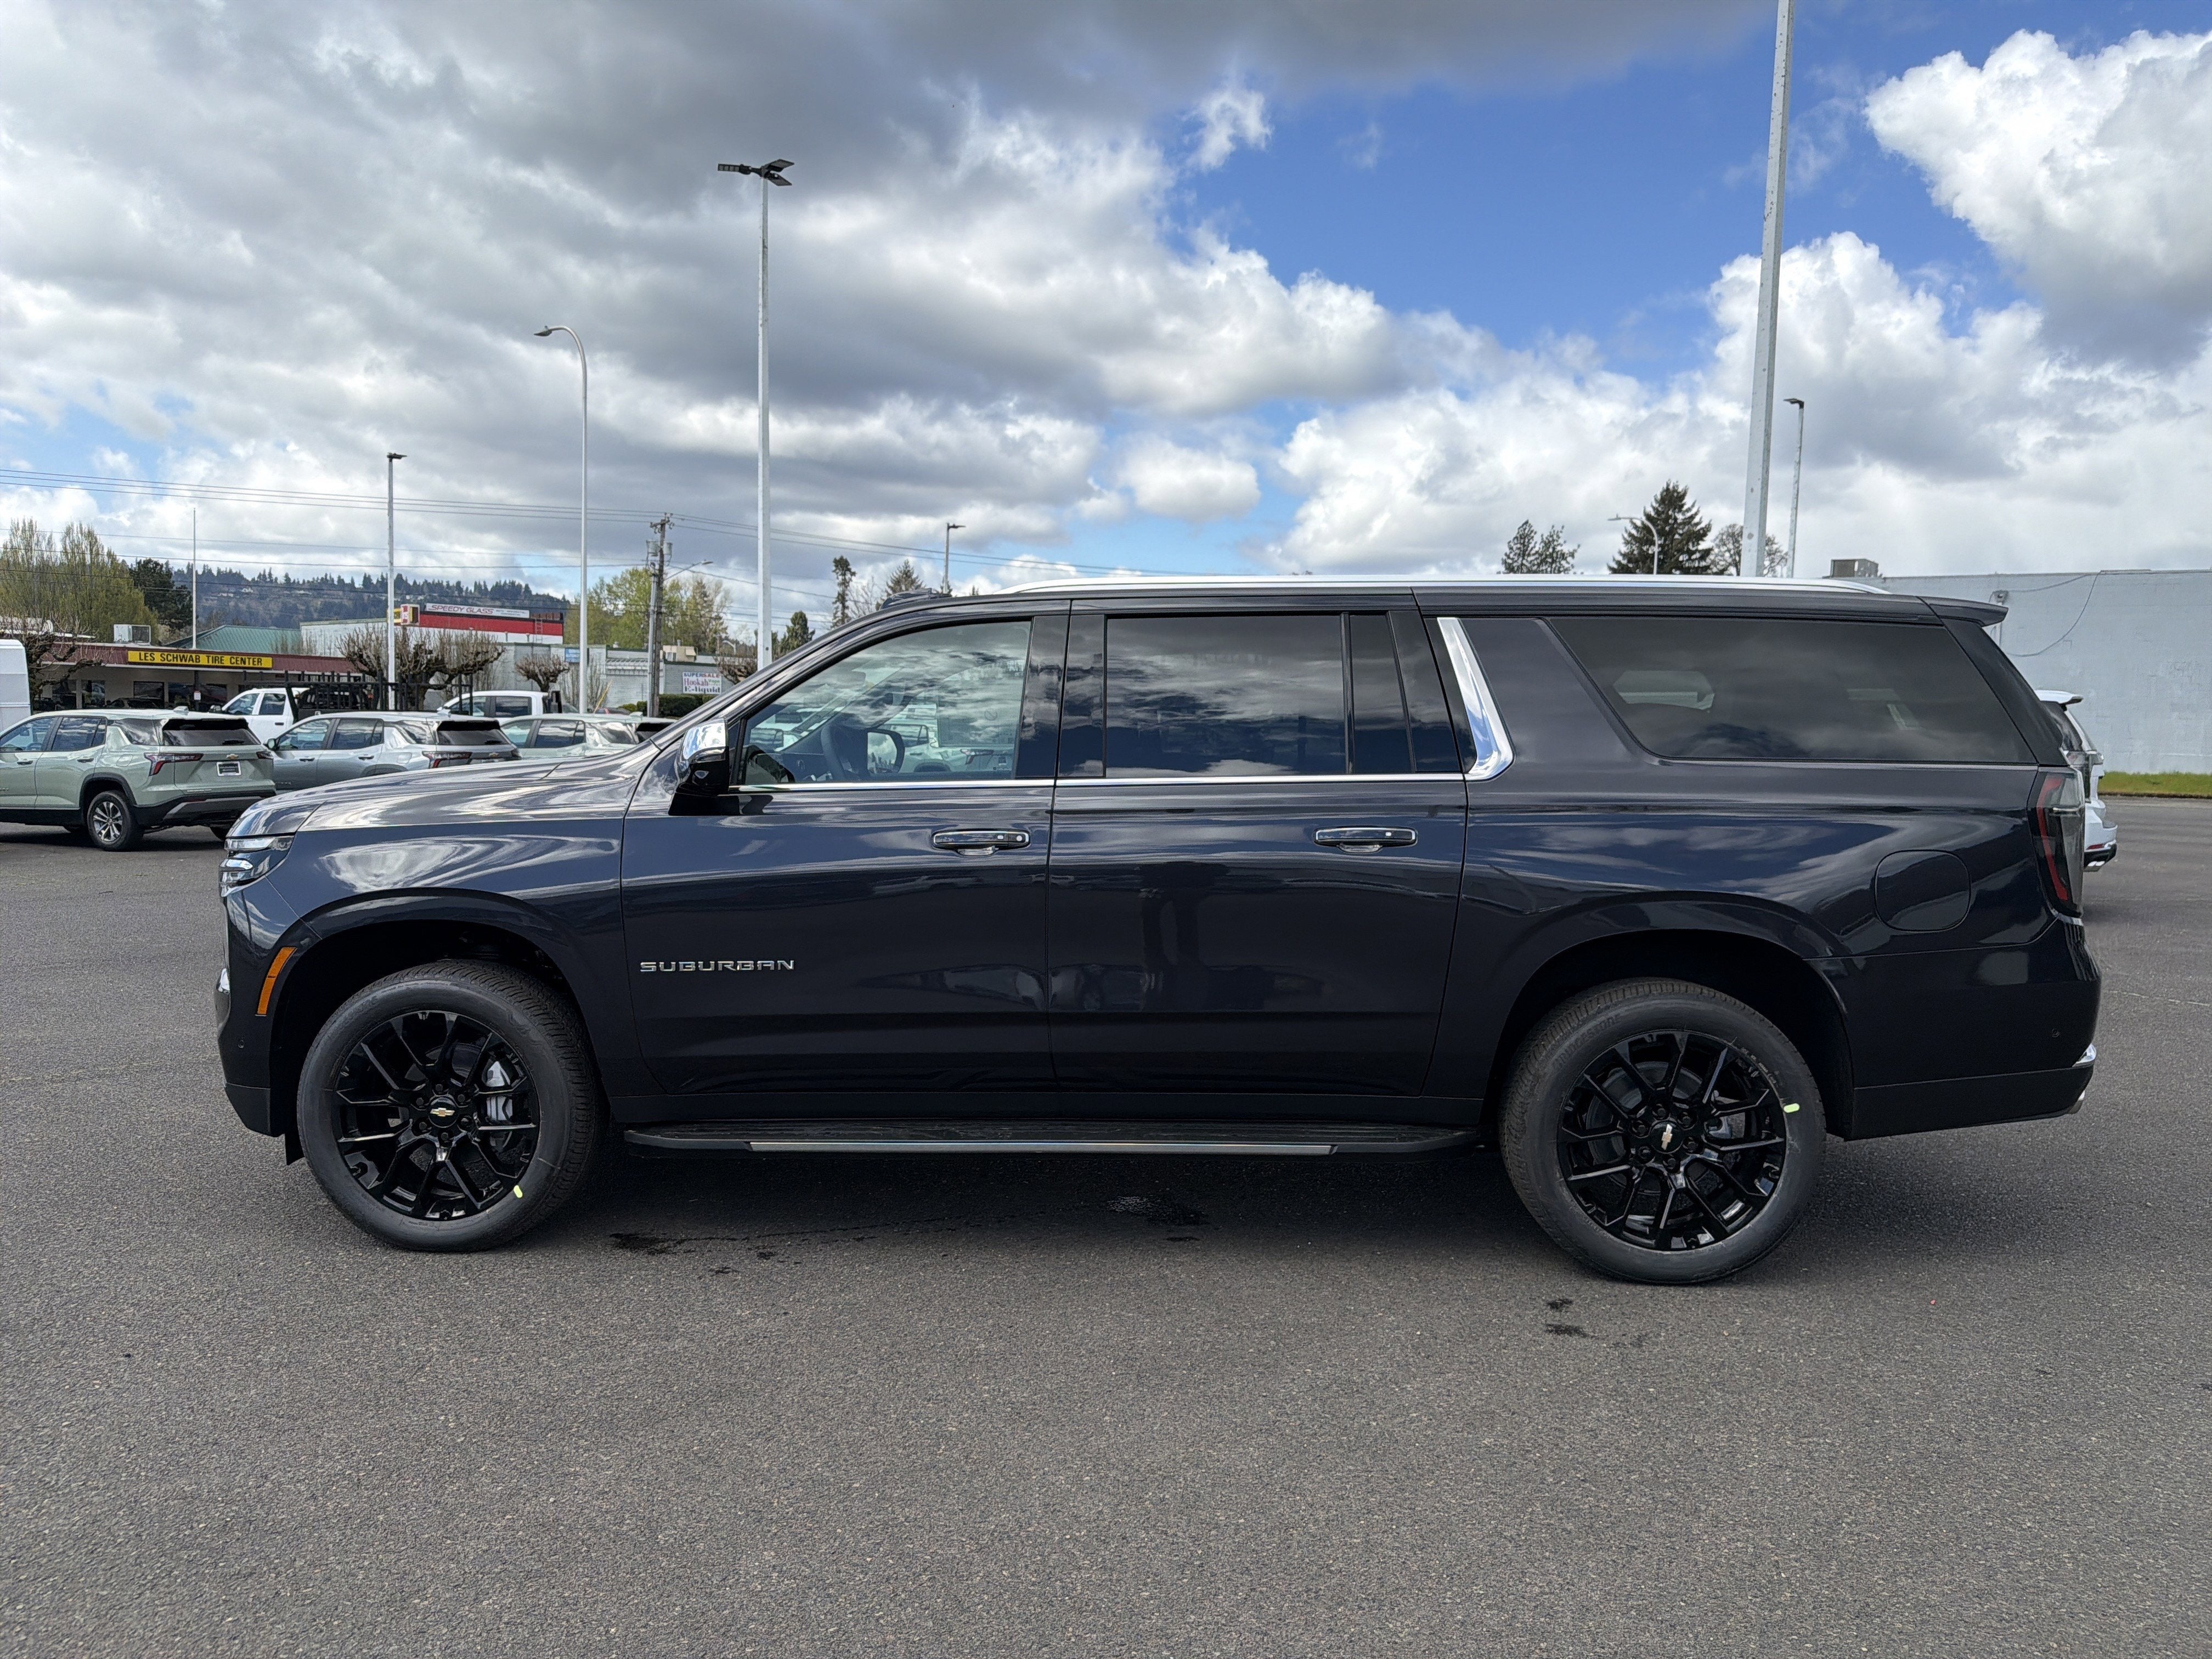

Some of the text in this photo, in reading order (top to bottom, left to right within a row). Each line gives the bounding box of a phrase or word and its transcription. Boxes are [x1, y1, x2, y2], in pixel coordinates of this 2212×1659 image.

[428, 605, 465, 613] SPEEDY
[139, 652, 263, 666] LES SCHWAB TIRE CENTER
[684, 678, 708, 686] Hookah
[640, 960, 794, 972] SUBURBAN
